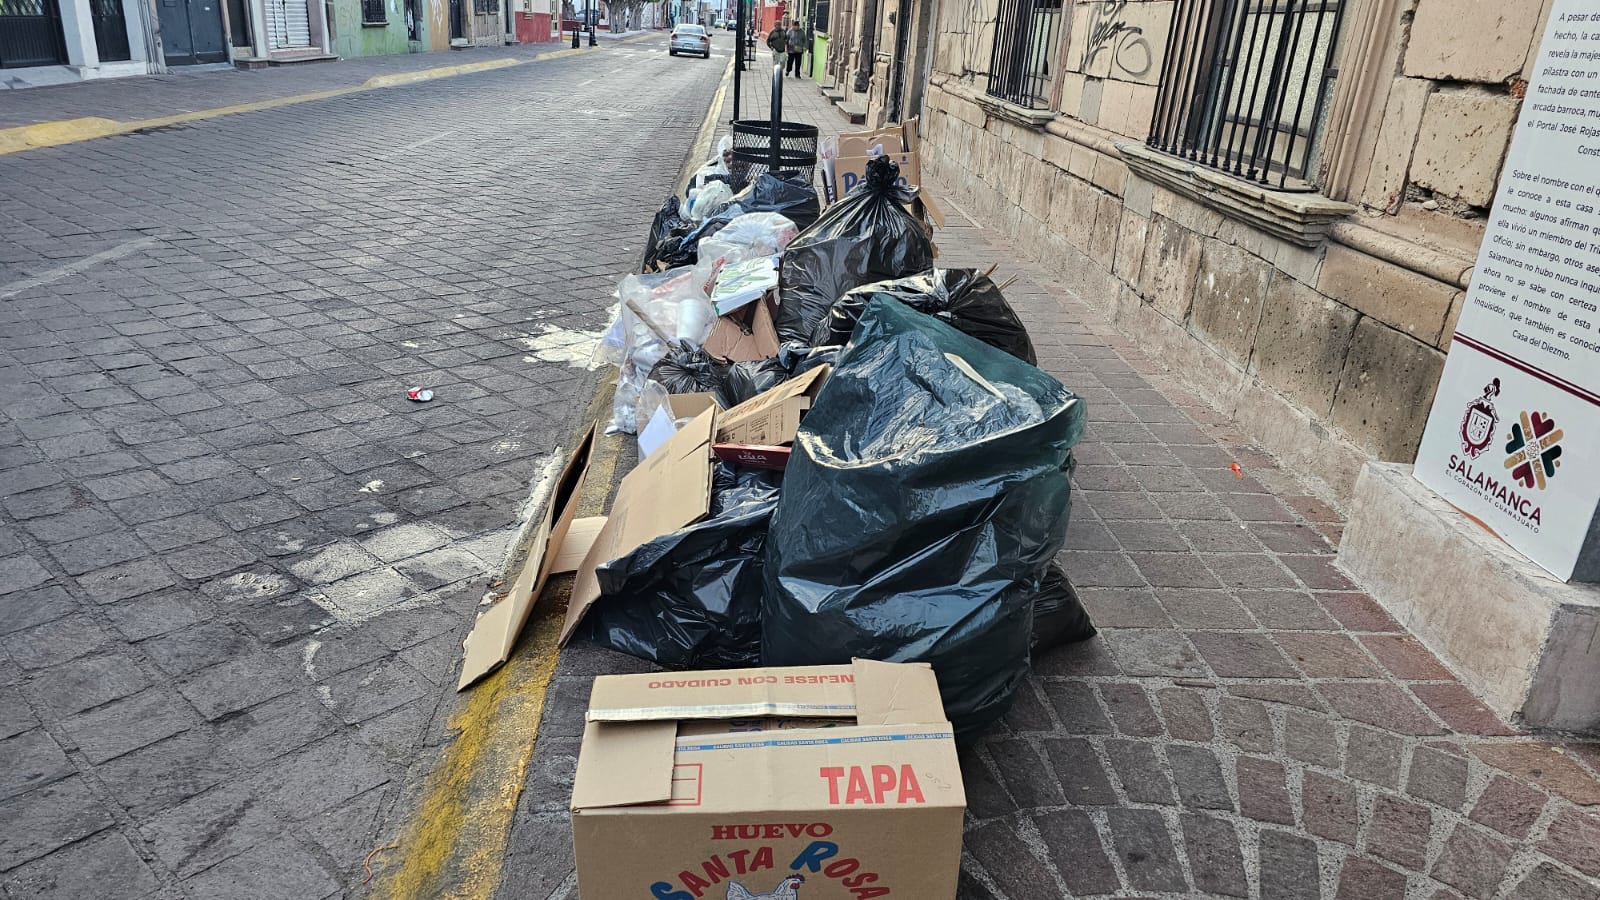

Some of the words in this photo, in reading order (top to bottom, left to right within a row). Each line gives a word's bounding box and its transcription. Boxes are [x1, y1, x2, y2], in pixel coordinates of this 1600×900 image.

[1559, 12, 1565, 21] A
[1566, 14, 1589, 23] pesar
[1554, 30, 1577, 42] hecho,
[1581, 30, 1588, 40] la
[1590, 33, 1600, 41] ca
[1548, 50, 1570, 59] revela
[1571, 50, 1578, 59] la
[1542, 67, 1569, 77] pilastra
[1570, 70, 1585, 78] con
[1587, 71, 1598, 79] un
[1537, 84, 1566, 95] fachada
[1567, 87, 1578, 96] de
[1532, 103, 1556, 112] arcada
[1557, 104, 1586, 117] barroca,
[1588, 109, 1600, 120] mu
[1527, 120, 1535, 128] el
[1536, 120, 1558, 131] Portal
[1559, 123, 1577, 134] José
[1512, 169, 1532, 181] Sobre
[1532, 174, 1541, 182] el
[1541, 177, 1569, 189] nombre
[1570, 183, 1585, 192] con
[1586, 185, 1595, 194] el
[1507, 186, 1514, 195] le
[1517, 190, 1542, 201] conoce
[1555, 199, 1571, 208] esta
[1576, 203, 1594, 213] casa
[1502, 204, 1527, 216] mucho:
[1529, 210, 1557, 223] algunos
[1559, 217, 1590, 232] afirman
[1497, 219, 1509, 229] ella
[1511, 223, 1526, 234] vivió
[1528, 228, 1538, 237] un
[1540, 231, 1573, 246] miembro
[1574, 240, 1588, 251] del
[1488, 250, 1523, 268] Salamanca
[1524, 263, 1534, 272] no
[1534, 265, 1554, 279] hubo
[1555, 273, 1579, 286] nunca
[1515, 241, 1526, 251] sin
[1528, 246, 1561, 263] embargo,
[1564, 257, 1584, 269] otros
[1586, 264, 1600, 277] ase
[1483, 266, 1501, 279] ahora
[1505, 275, 1514, 283] no
[1517, 279, 1526, 287] se
[1529, 283, 1547, 295] sabe
[1550, 290, 1565, 300] con
[1568, 297, 1597, 313] certeza
[1474, 296, 1506, 316] Inquisidor,
[1509, 311, 1522, 322] que
[1525, 317, 1555, 335] también
[1557, 331, 1567, 340] es
[1478, 282, 1506, 298] proviene
[1512, 294, 1519, 302] el
[1523, 299, 1551, 315] nombre
[1557, 311, 1568, 321] de
[1574, 318, 1591, 330] esta
[1512, 329, 1528, 342] Casa
[1529, 336, 1541, 348] del
[1541, 341, 1571, 360] Diezmo.
[1445, 469, 1454, 478] EL
[1484, 494, 1493, 504] DE
[1494, 501, 1539, 534] GUANAJUATO
[1448, 454, 1541, 526] SALAMANCA
[648, 677, 730, 689] CUIDADO
[738, 675, 777, 686] CON
[820, 764, 926, 806] TAPA
[710, 822, 834, 841] HUEVO
[650, 846, 774, 900] SANTA
[790, 840, 891, 900] ROSA
